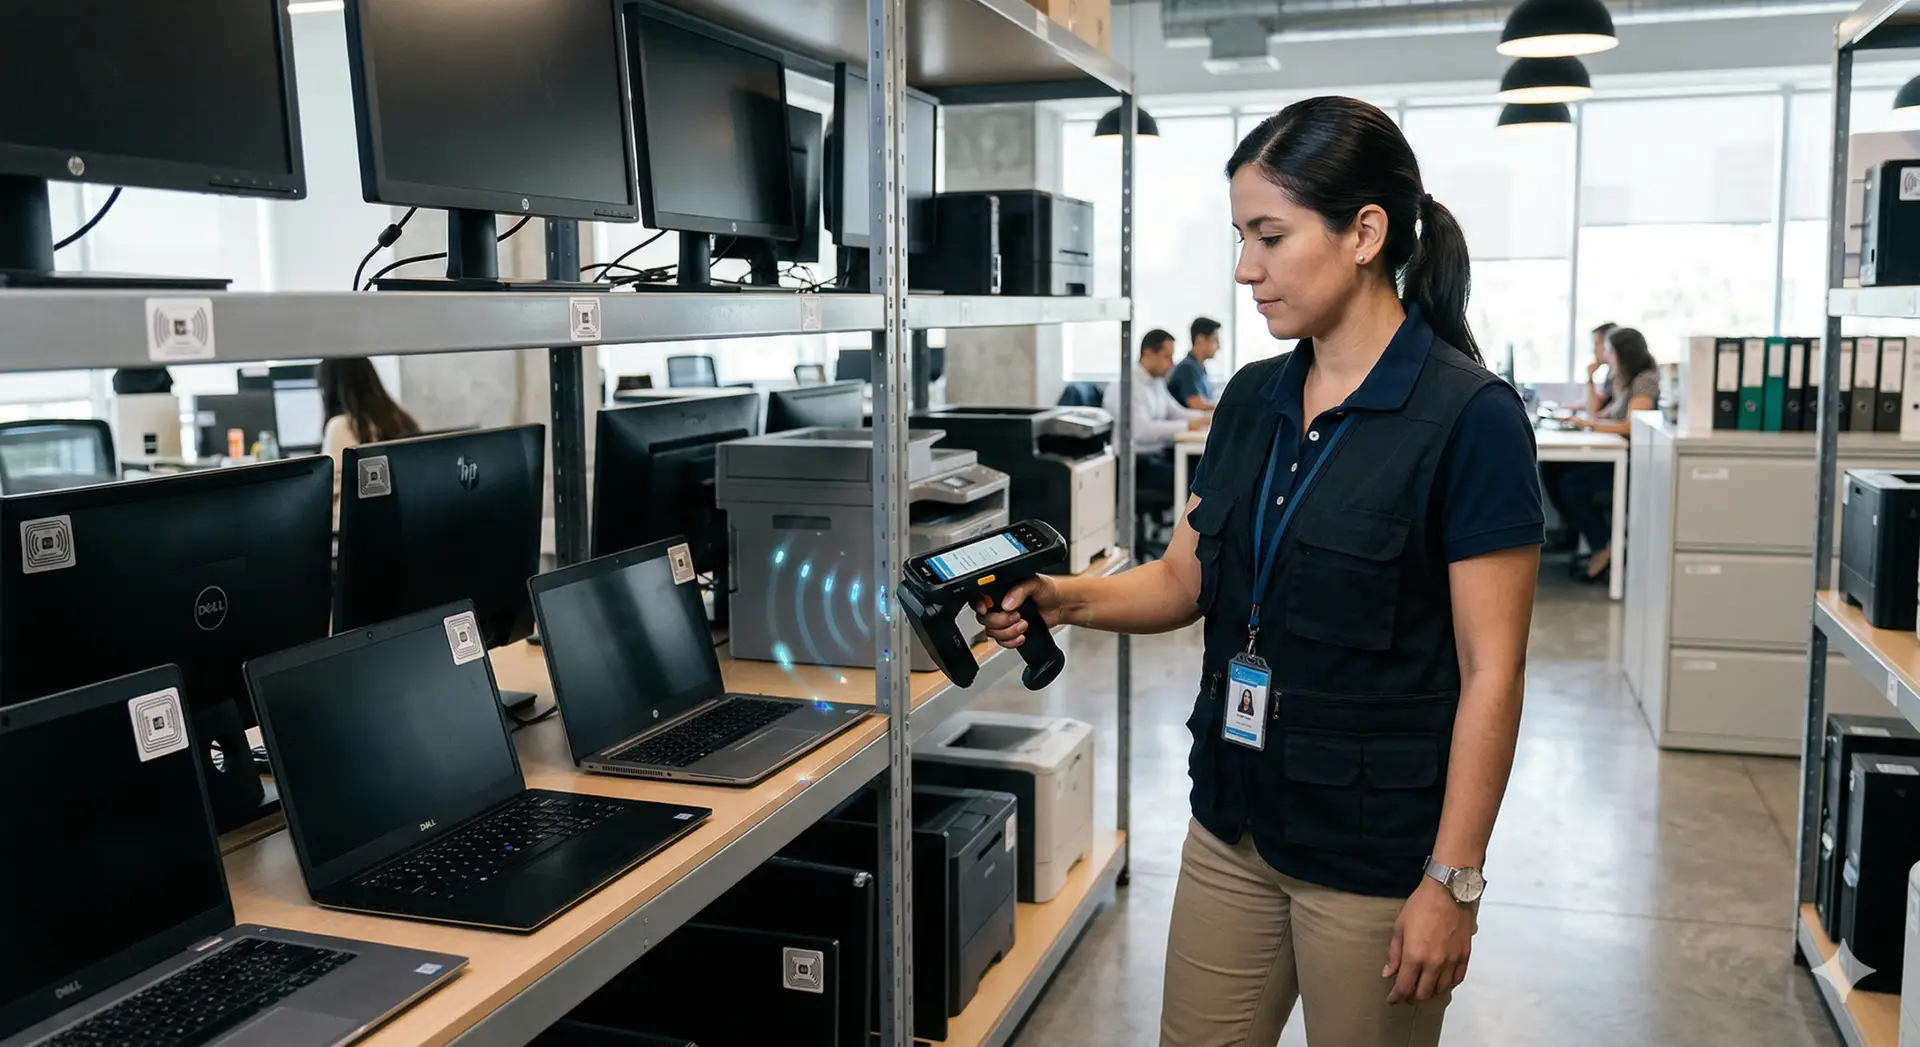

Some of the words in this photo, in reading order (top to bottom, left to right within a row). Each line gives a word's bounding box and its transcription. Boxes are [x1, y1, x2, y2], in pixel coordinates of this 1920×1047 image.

[457, 455, 478, 491] hp
[198, 600, 225, 616] DELL
[420, 818, 437, 832] DELL
